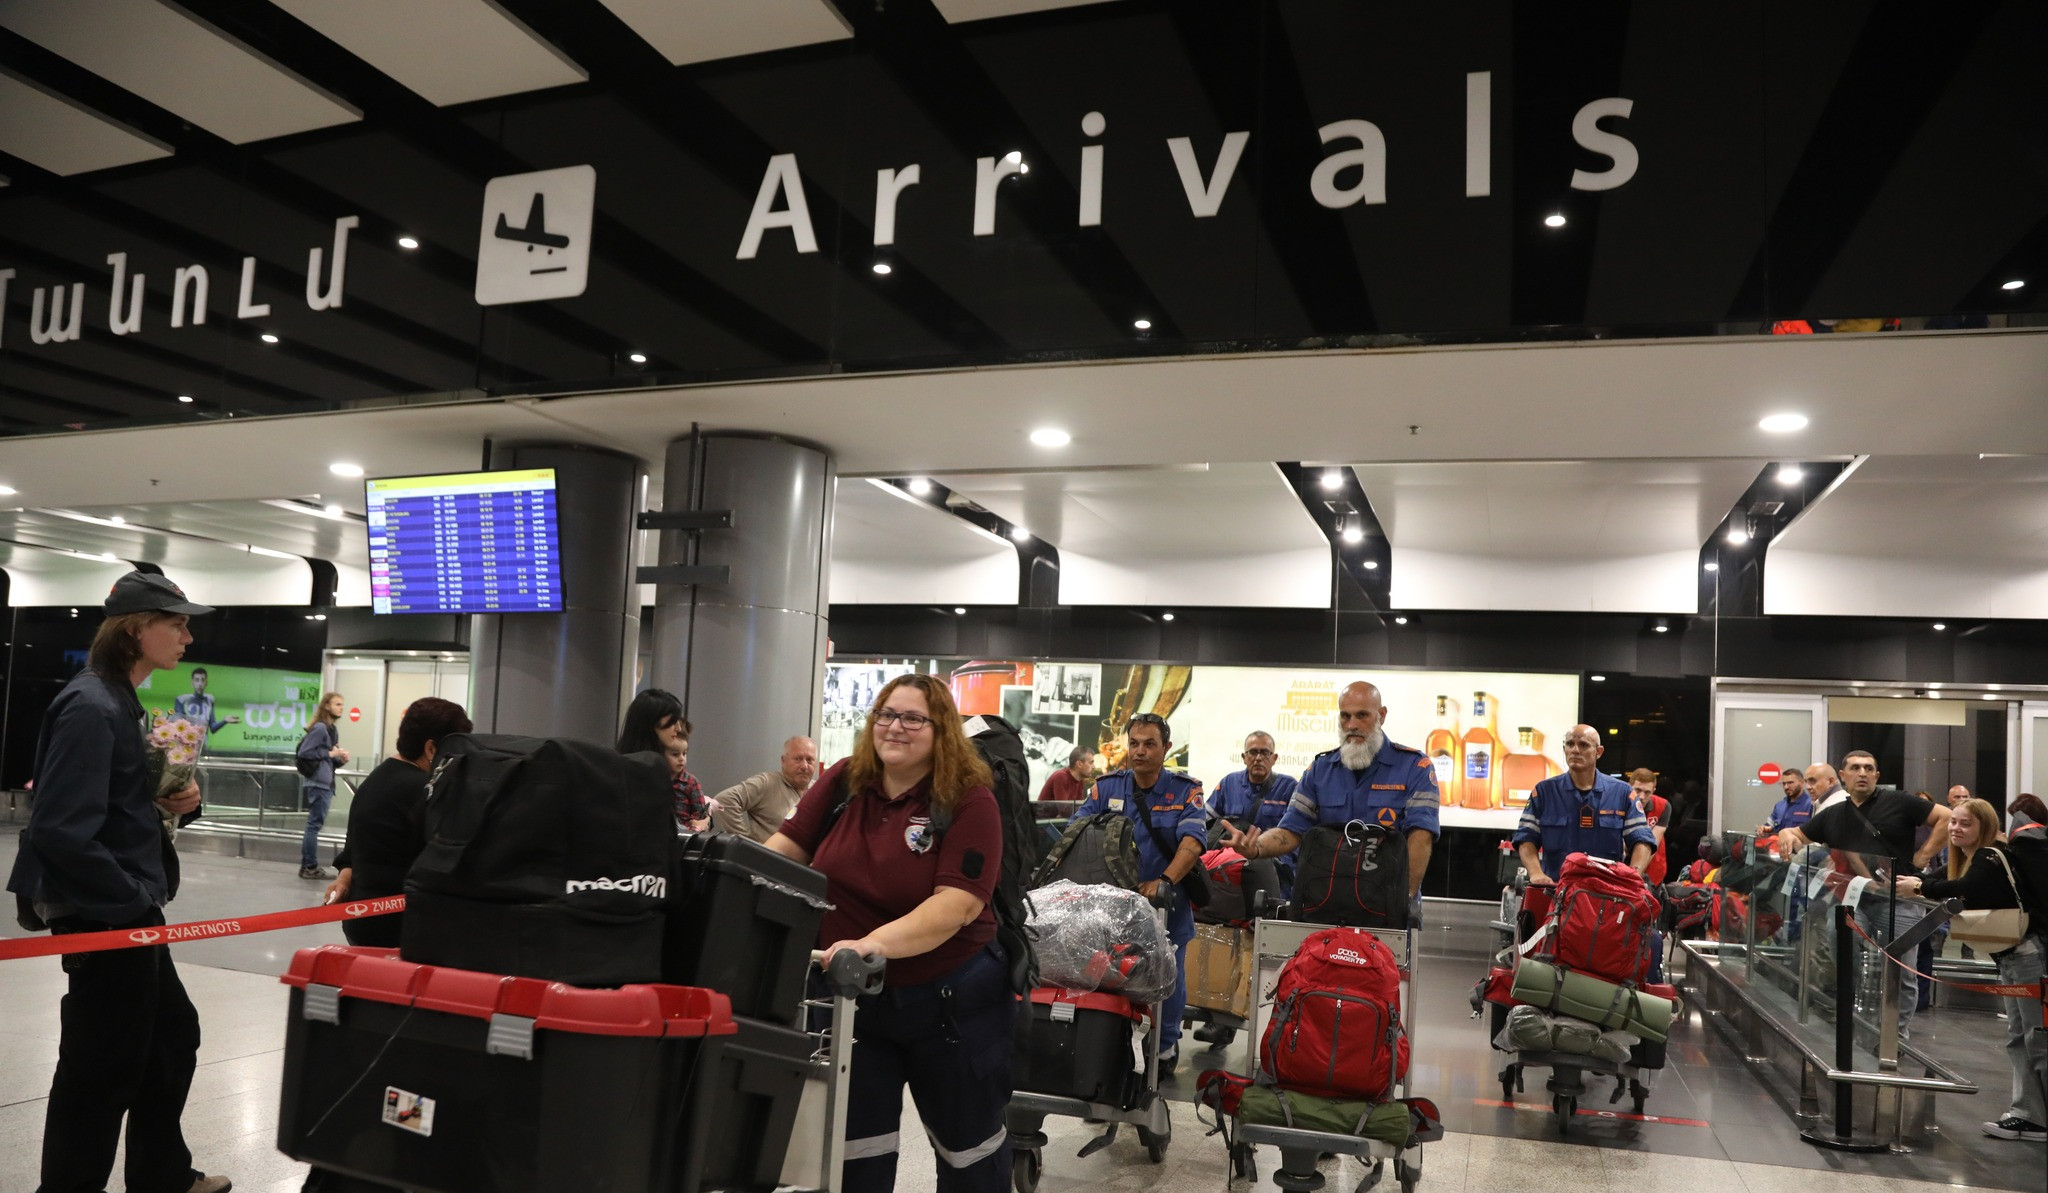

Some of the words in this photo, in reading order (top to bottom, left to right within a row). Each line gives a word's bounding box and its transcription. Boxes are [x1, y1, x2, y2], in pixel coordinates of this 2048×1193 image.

[736, 71, 1640, 259] Arrivals
[1277, 713, 1338, 733] Museu
[165, 921, 241, 940] ZVARTNOTS
